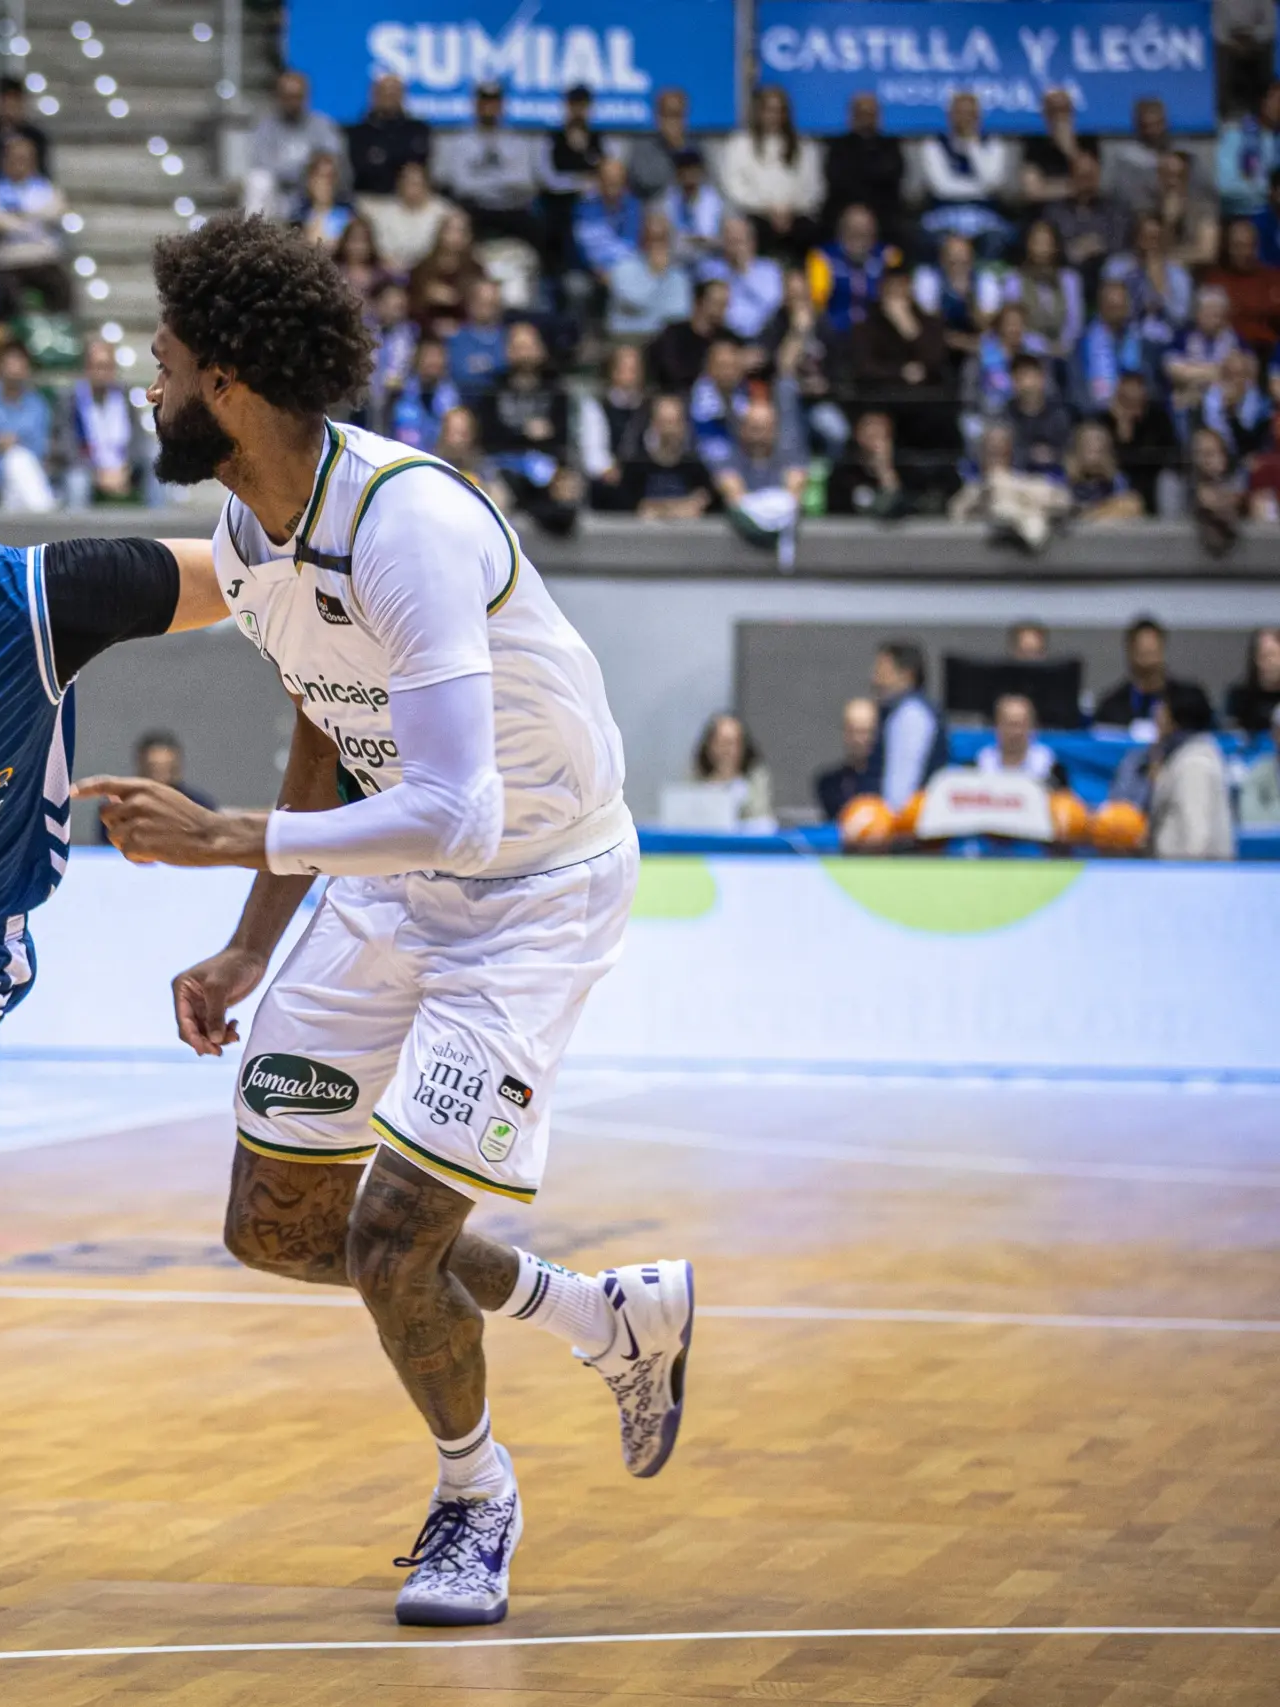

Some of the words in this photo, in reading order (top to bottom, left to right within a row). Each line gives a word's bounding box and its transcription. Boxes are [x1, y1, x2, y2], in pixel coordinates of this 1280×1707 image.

[368, 12, 654, 92] SUMIAL
[760, 24, 1001, 73] CASTILLA
[1020, 25, 1059, 82] Y
[1072, 14, 1206, 72] LEÓN
[413, 1071, 472, 1127] laga
